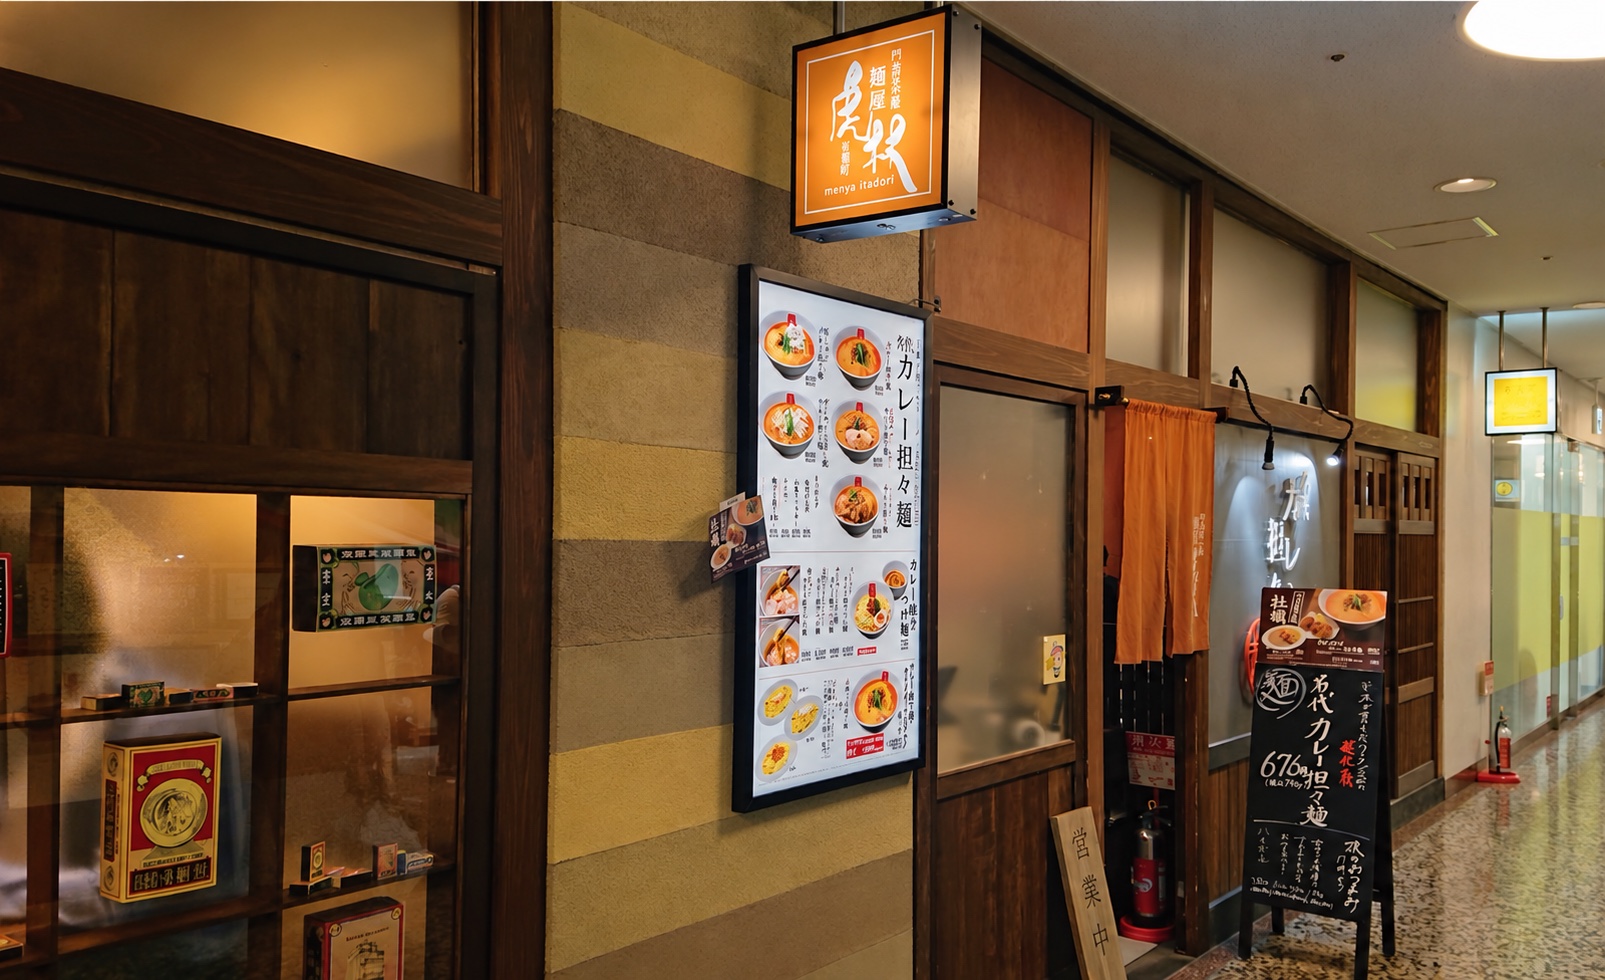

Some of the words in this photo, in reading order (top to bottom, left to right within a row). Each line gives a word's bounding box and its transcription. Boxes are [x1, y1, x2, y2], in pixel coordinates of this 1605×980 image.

[824, 184, 856, 196] menya
[859, 174, 895, 190] itadori
[1071, 827, 1110, 957] 営業中
